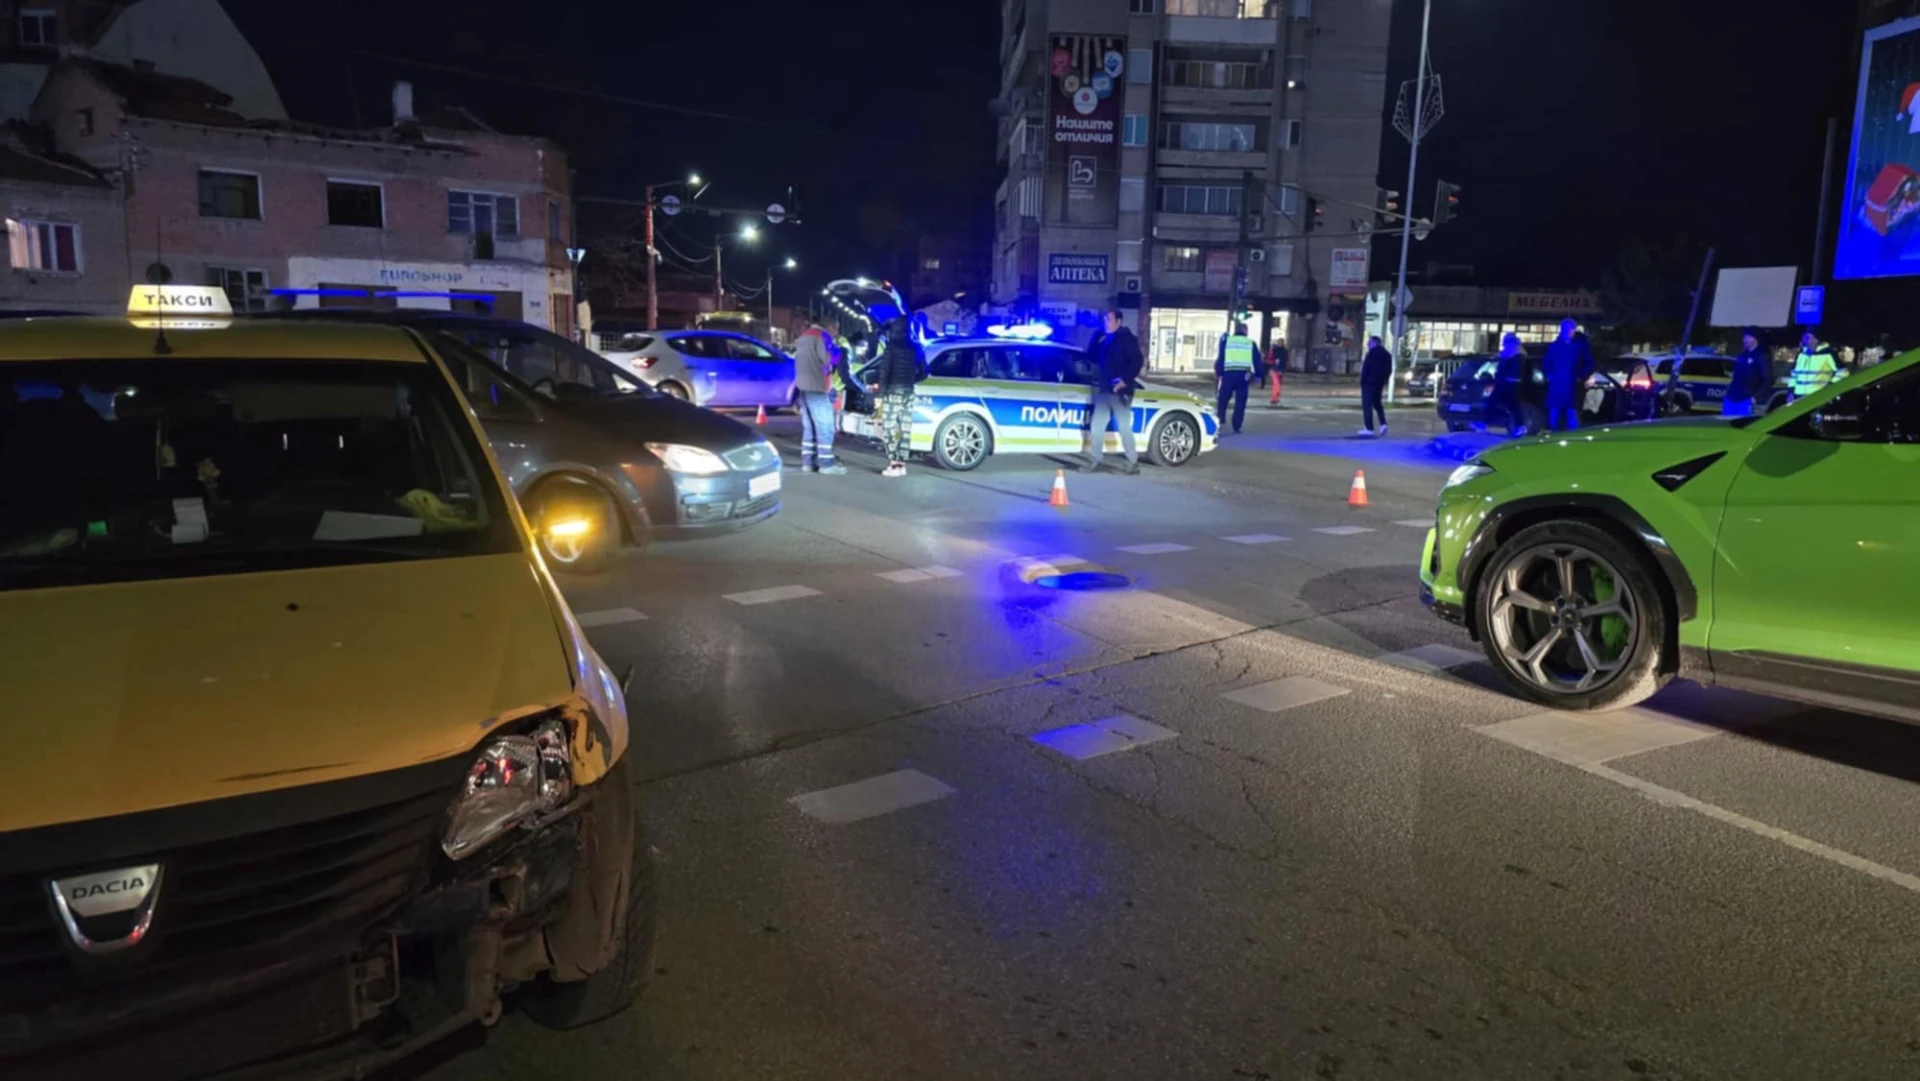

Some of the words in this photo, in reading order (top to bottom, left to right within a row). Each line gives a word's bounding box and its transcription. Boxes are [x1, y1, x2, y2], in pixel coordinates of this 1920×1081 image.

[1056, 115, 1114, 130] Нашите
[1055, 132, 1113, 143] отличия
[1050, 267, 1105, 281] АПТЕКА
[143, 294, 213, 306] ТАКСИ
[72, 877, 145, 899] DACIA
